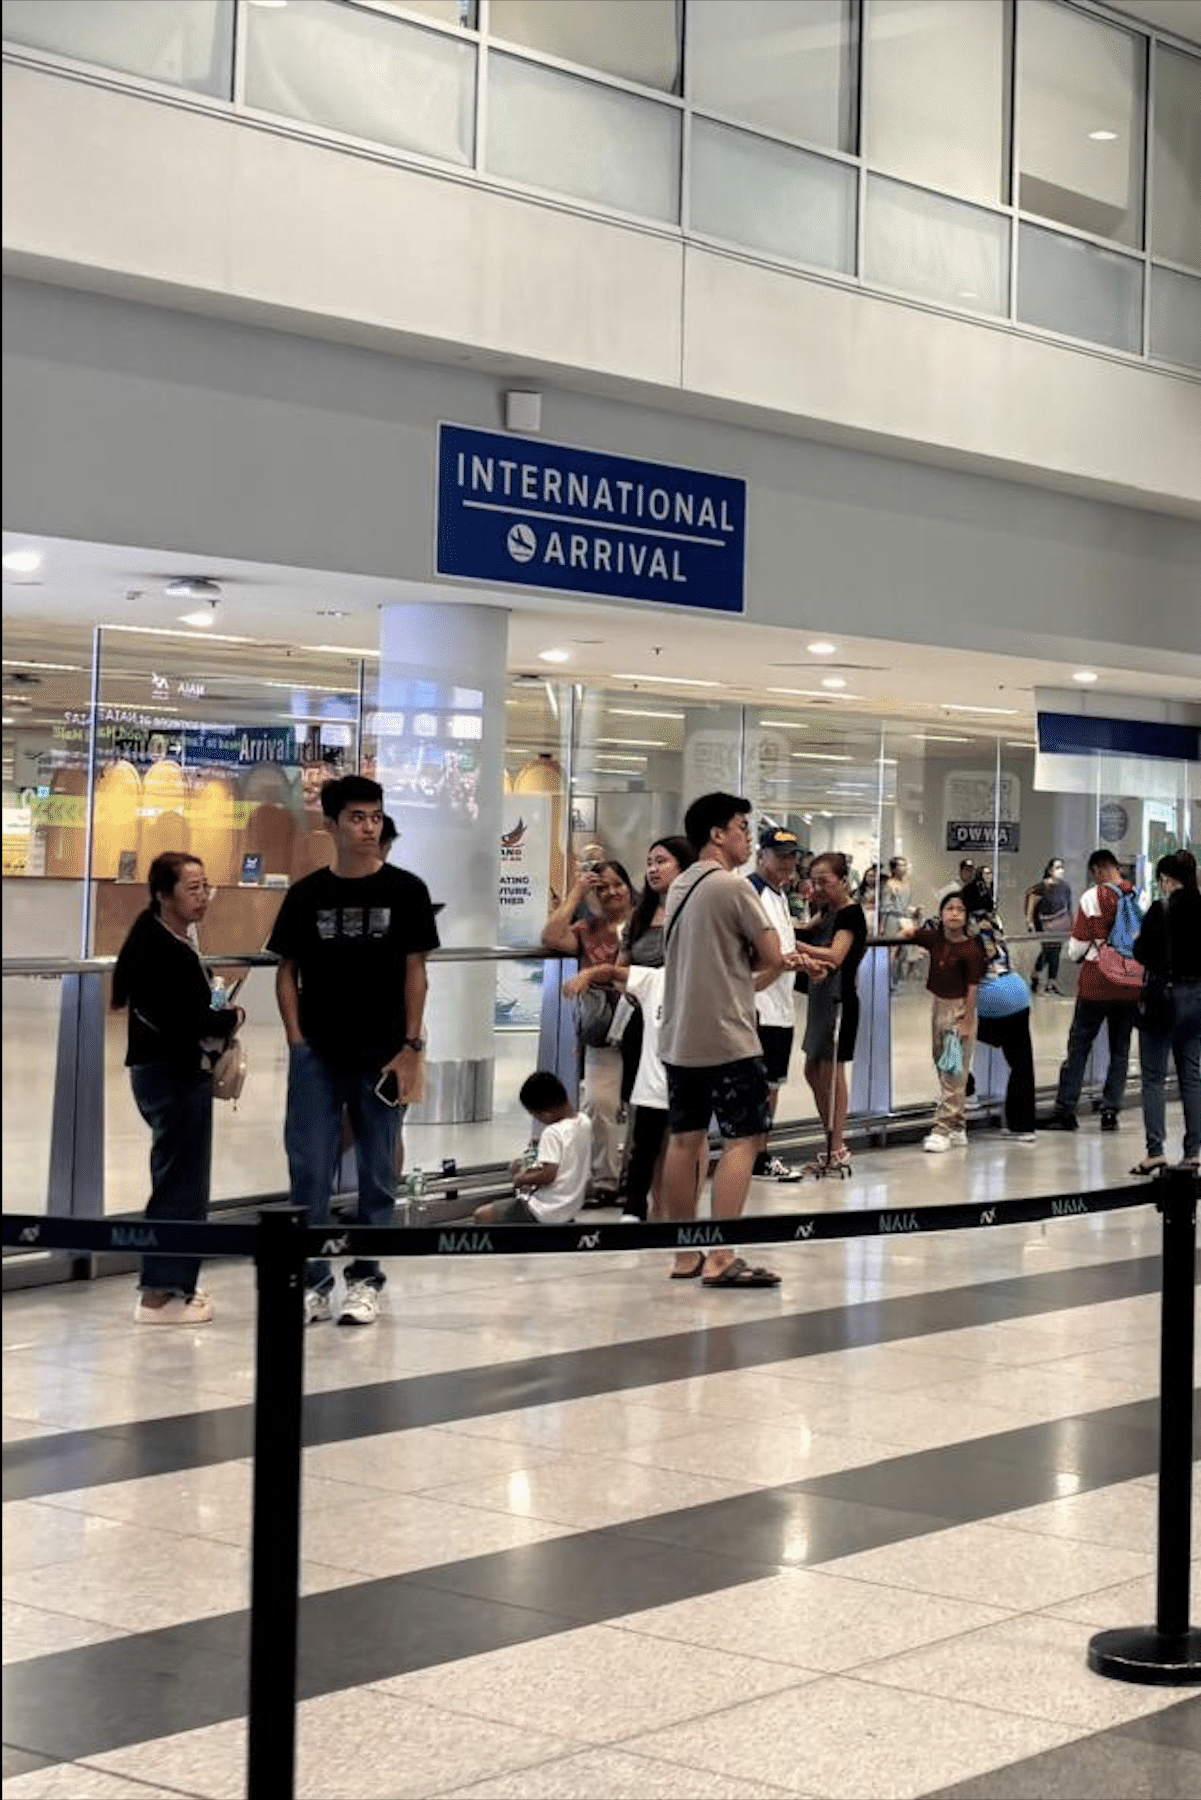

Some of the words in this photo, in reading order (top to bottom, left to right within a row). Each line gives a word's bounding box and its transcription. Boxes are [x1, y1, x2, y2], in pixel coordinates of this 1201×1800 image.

[457, 452, 734, 531] INTERNATIONAL
[544, 532, 687, 582] ARRIVAL
[240, 732, 290, 761] Arrival
